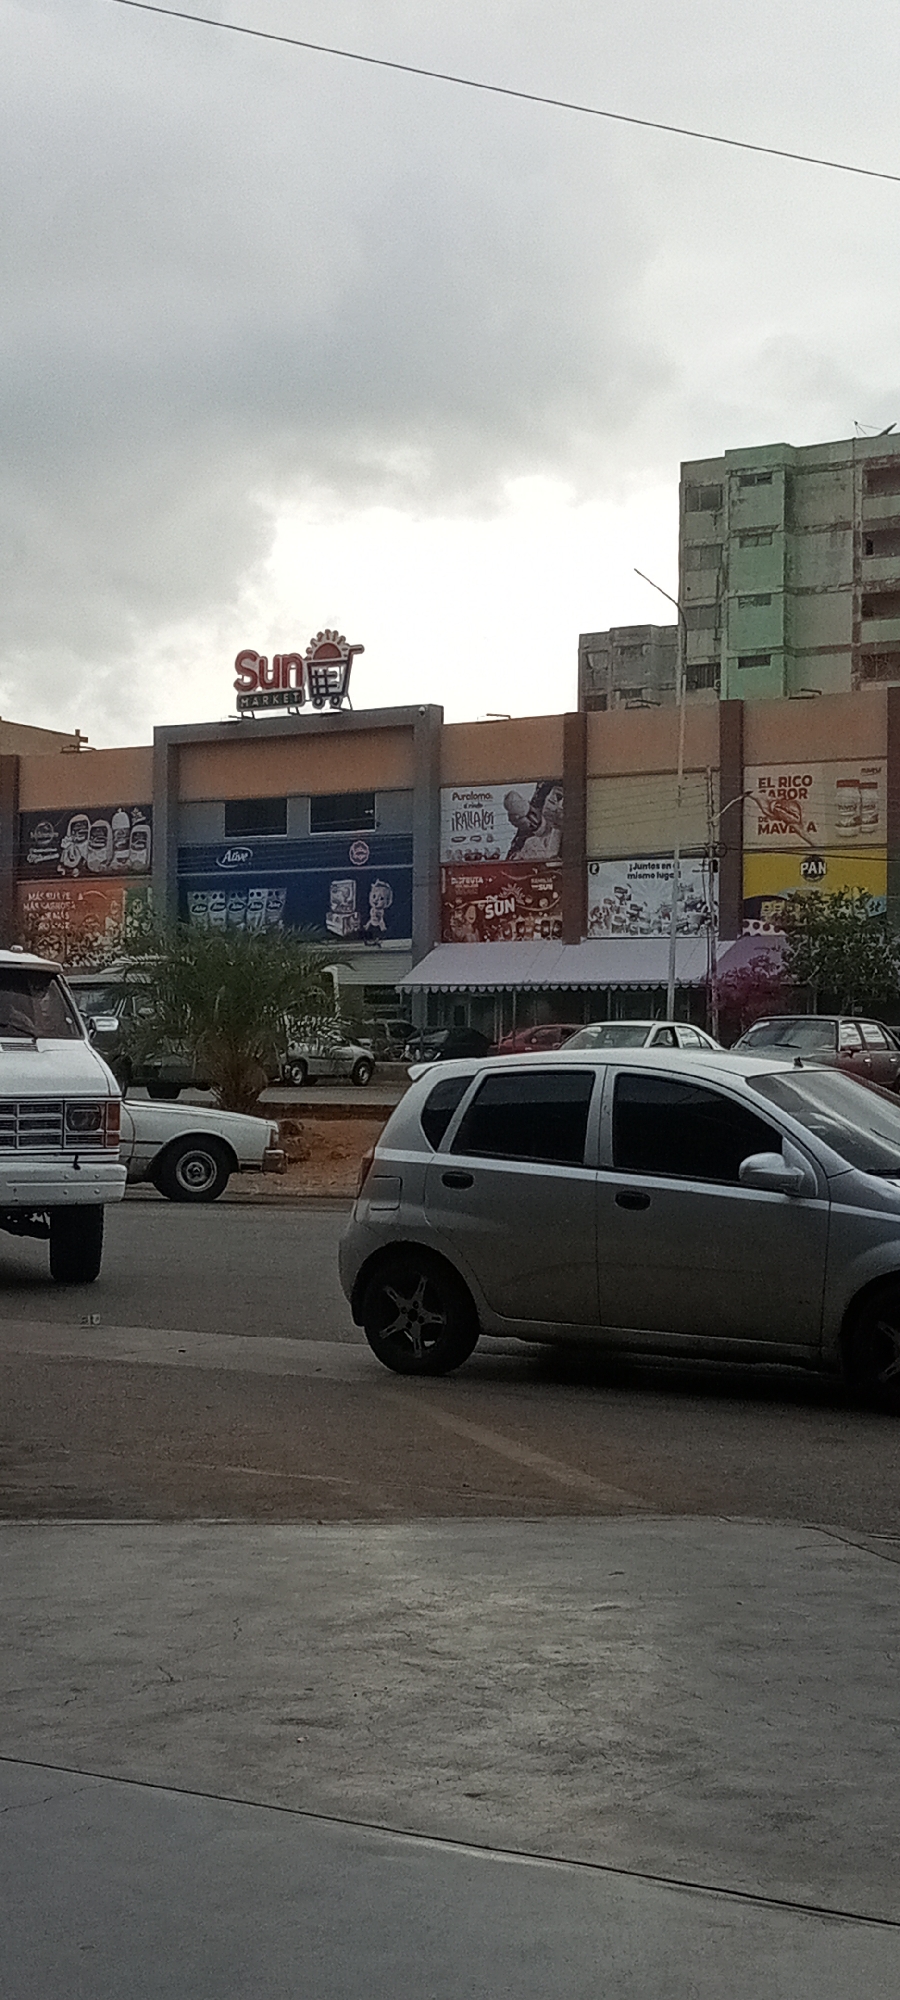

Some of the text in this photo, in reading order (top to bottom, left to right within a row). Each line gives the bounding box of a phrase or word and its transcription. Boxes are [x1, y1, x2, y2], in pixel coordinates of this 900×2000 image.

[233, 649, 303, 692] Sun
[240, 692, 301, 708] MARKET
[758, 775, 813, 789] EL RICO
[629, 862, 660, 872] ¡Juntos
[800, 861, 827, 875] PAN
[627, 870, 682, 881] mismo luga!
[485, 897, 515, 919] SUN
